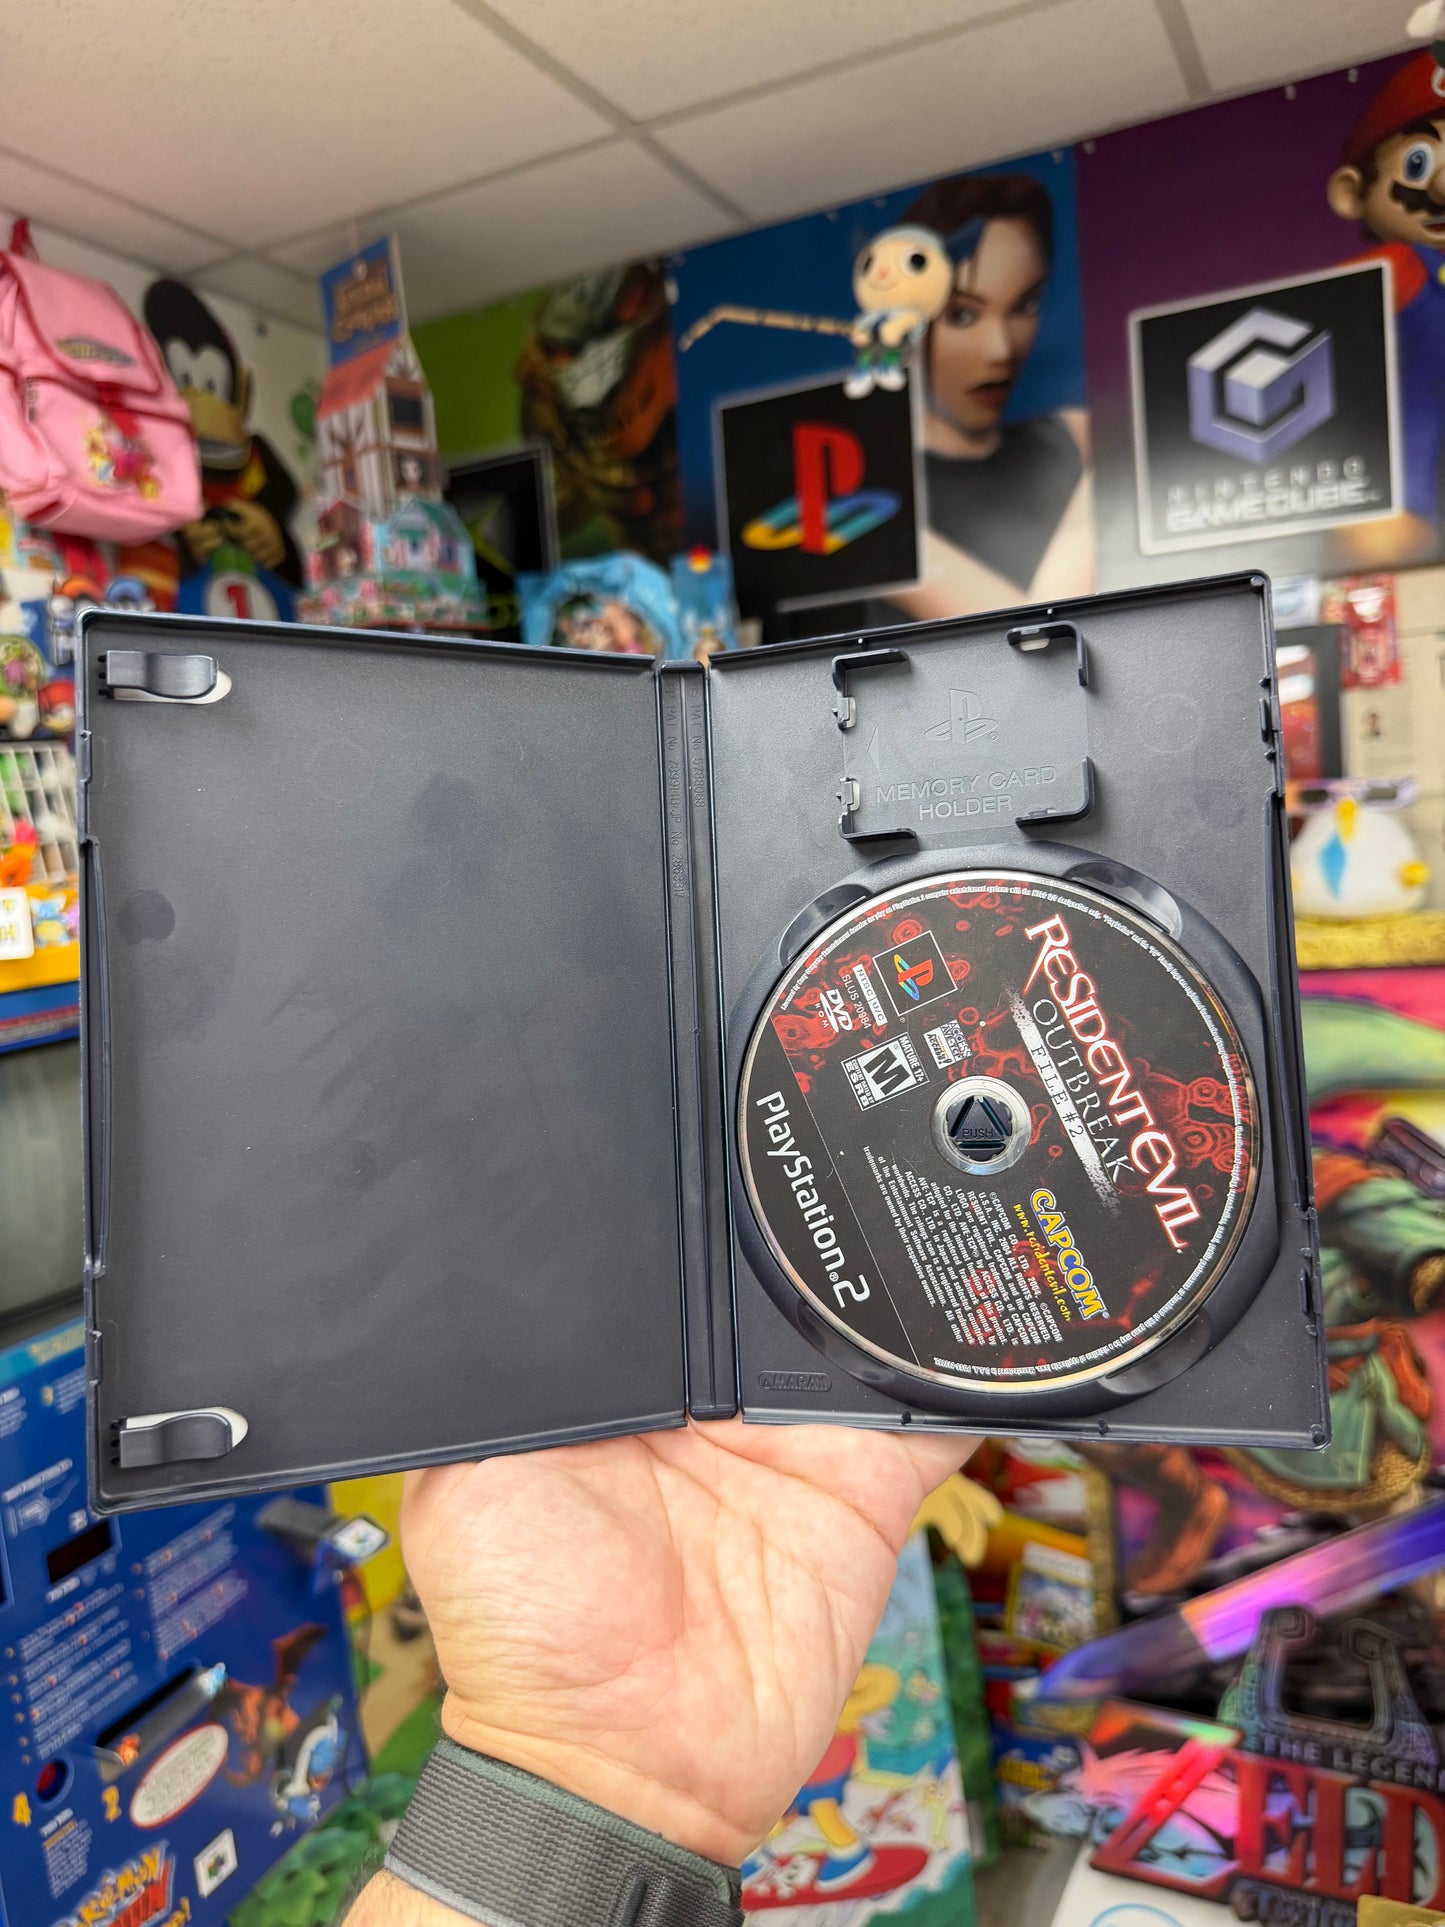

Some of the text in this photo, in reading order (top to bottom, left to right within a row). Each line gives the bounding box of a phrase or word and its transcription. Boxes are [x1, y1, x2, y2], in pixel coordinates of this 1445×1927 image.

[1167, 456, 1366, 503] NINTENDO
[1166, 478, 1369, 532] GAMECUBE
[876, 765, 1057, 803] MEMORY CARD
[919, 794, 1013, 821] HOLDER
[825, 988, 852, 1029] DVD
[840, 973, 872, 1029] SLUS 20984
[856, 968, 884, 1021] NTSC U/C
[898, 1035, 926, 1083] MATURE 17+
[947, 1020, 972, 1058] ACCESS
[843, 1061, 870, 1107] ESRB
[863, 1047, 910, 1094] M
[1032, 997, 1134, 1183] OUTBREAK
[1028, 1043, 1085, 1140] FILE #2
[962, 1128, 995, 1139] PUSH
[890, 1163, 912, 1200] worldwide.
[904, 1170, 921, 1198] ACCESS
[862, 1145, 936, 1307] trademarks are owned by their respective owners.
[907, 1201, 918, 1215] The
[912, 1215, 929, 1240] ratings
[876, 1155, 964, 1344] of the Entertainment Software Association. All other
[924, 1240, 936, 1256] icon
[932, 1233, 941, 1242] in
[935, 1242, 951, 1265] Japan
[917, 1176, 935, 1206] AVE-TCP
[931, 1209, 940, 1217] is
[939, 1228, 961, 1266] registered
[958, 1268, 979, 1305] trademark
[975, 1307, 991, 1332] owned
[986, 1335, 997, 1346] by
[929, 1181, 1007, 1345] adopted for the Internet function of this product.
[931, 1256, 940, 1265] is
[946, 1265, 958, 1280] and
[955, 1188, 1030, 1344] LOGO are registered trademarks of CAPCOM
[966, 1190, 987, 1226] RESIDENT
[992, 1248, 1012, 1280] CAPCOM
[1007, 1281, 1019, 1296] and
[1015, 1297, 1026, 1310] the
[1021, 1311, 1041, 1344] CAPCOM
[1012, 1203, 1072, 1322] www.residentevil.com
[937, 1271, 959, 1308] registered
[953, 1280, 971, 1311] selected
[974, 1258, 985, 1269] by
[980, 1269, 998, 1298] ACCESS
[1010, 1337, 1019, 1345] is
[998, 1236, 1011, 1255] 2004
[1007, 1256, 1018, 1270] ALL
[1014, 1272, 1032, 1300] RIGHTS
[1027, 1301, 1051, 1342] RESERVED.
[954, 1307, 975, 1344] trademark
[966, 1311, 986, 1345] countries
[1263, 1733, 1321, 1761] THE
